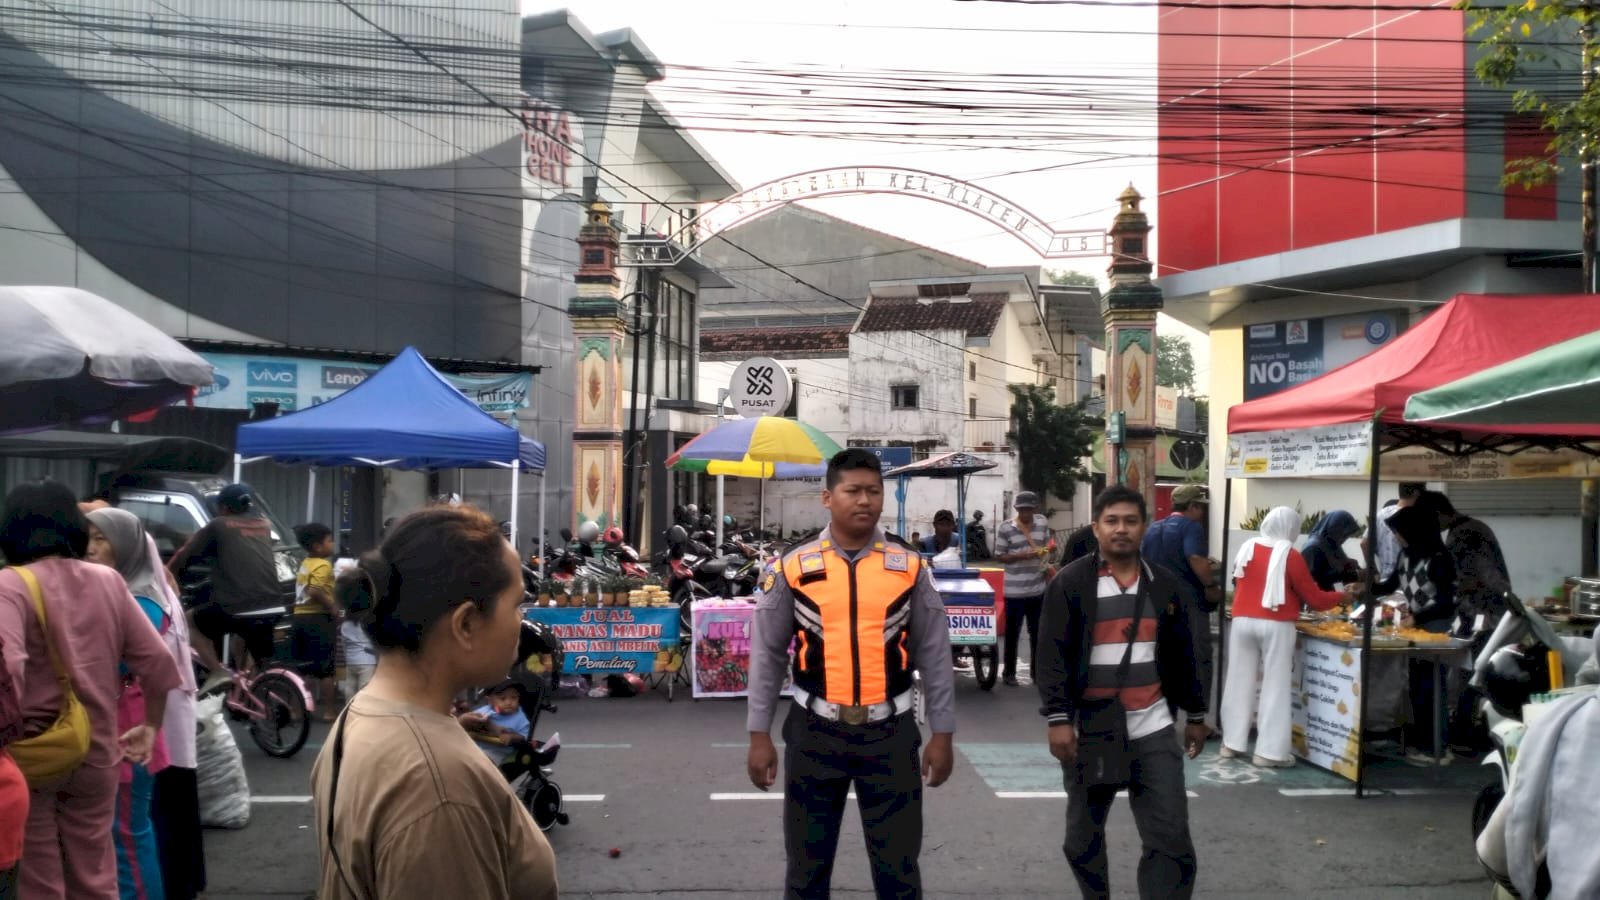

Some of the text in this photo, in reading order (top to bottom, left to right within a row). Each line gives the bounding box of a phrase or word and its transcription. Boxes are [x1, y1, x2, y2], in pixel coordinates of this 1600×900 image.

[528, 154, 572, 189] CELL
[889, 172, 936, 194] KEL.
[946, 181, 1030, 232] KLATEN
[1288, 358, 1323, 371] Basah
[251, 368, 293, 383] vivo
[1250, 361, 1286, 384] NO
[1288, 371, 1313, 383] Basi
[477, 386, 526, 402] Infinix
[741, 399, 776, 407] PUSAT
[580, 609, 634, 623] JUAL
[551, 624, 662, 639] NANAS MADU
[707, 621, 744, 639] KUE
[575, 655, 637, 671] Pemalang
